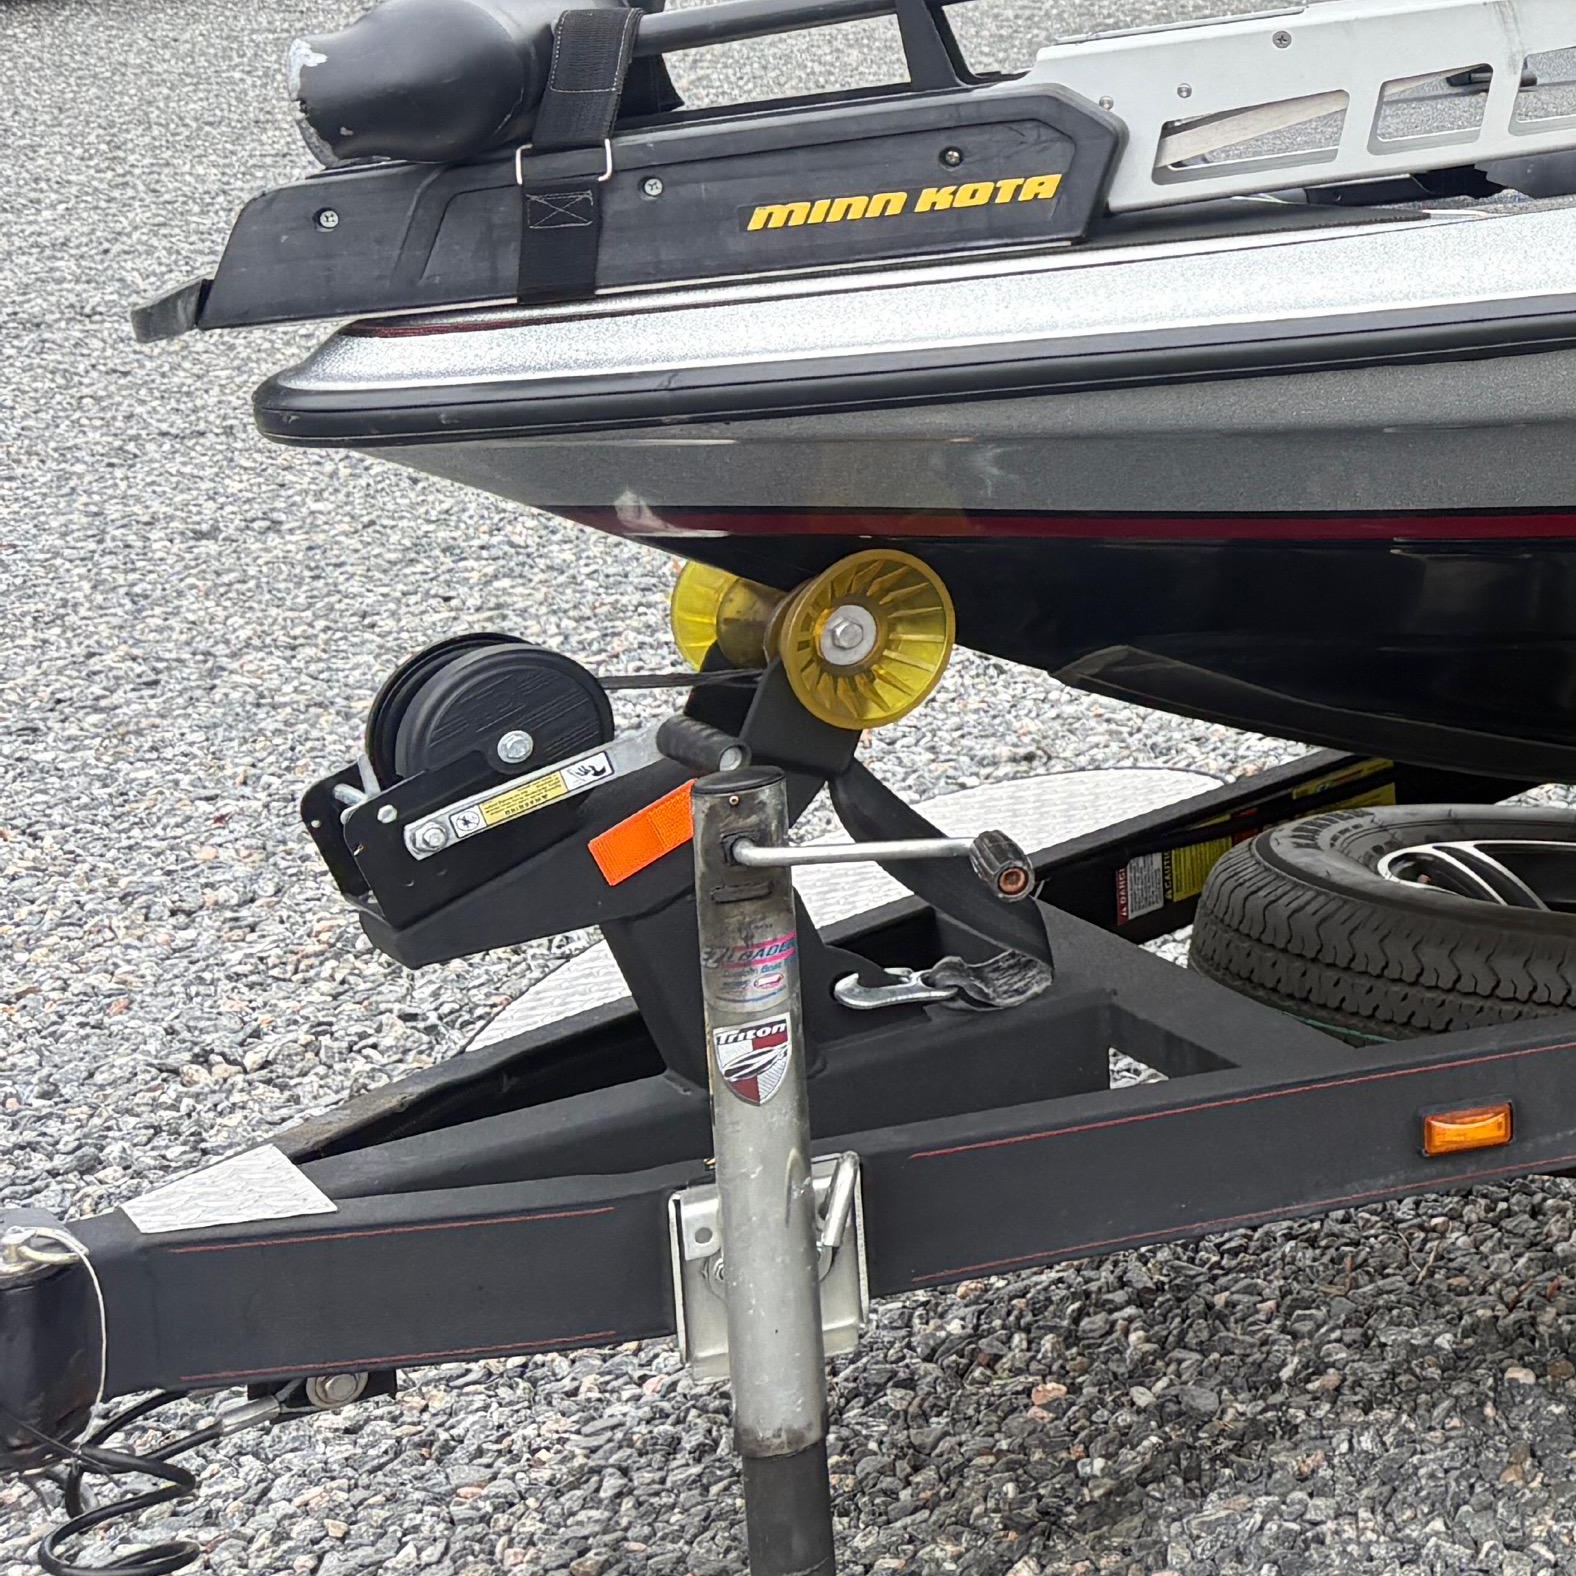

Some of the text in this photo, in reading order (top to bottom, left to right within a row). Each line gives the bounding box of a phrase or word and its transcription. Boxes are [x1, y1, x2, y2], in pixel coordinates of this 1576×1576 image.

[747, 173, 1062, 232] MINN KOTA
[716, 1023, 787, 1045] Triton
